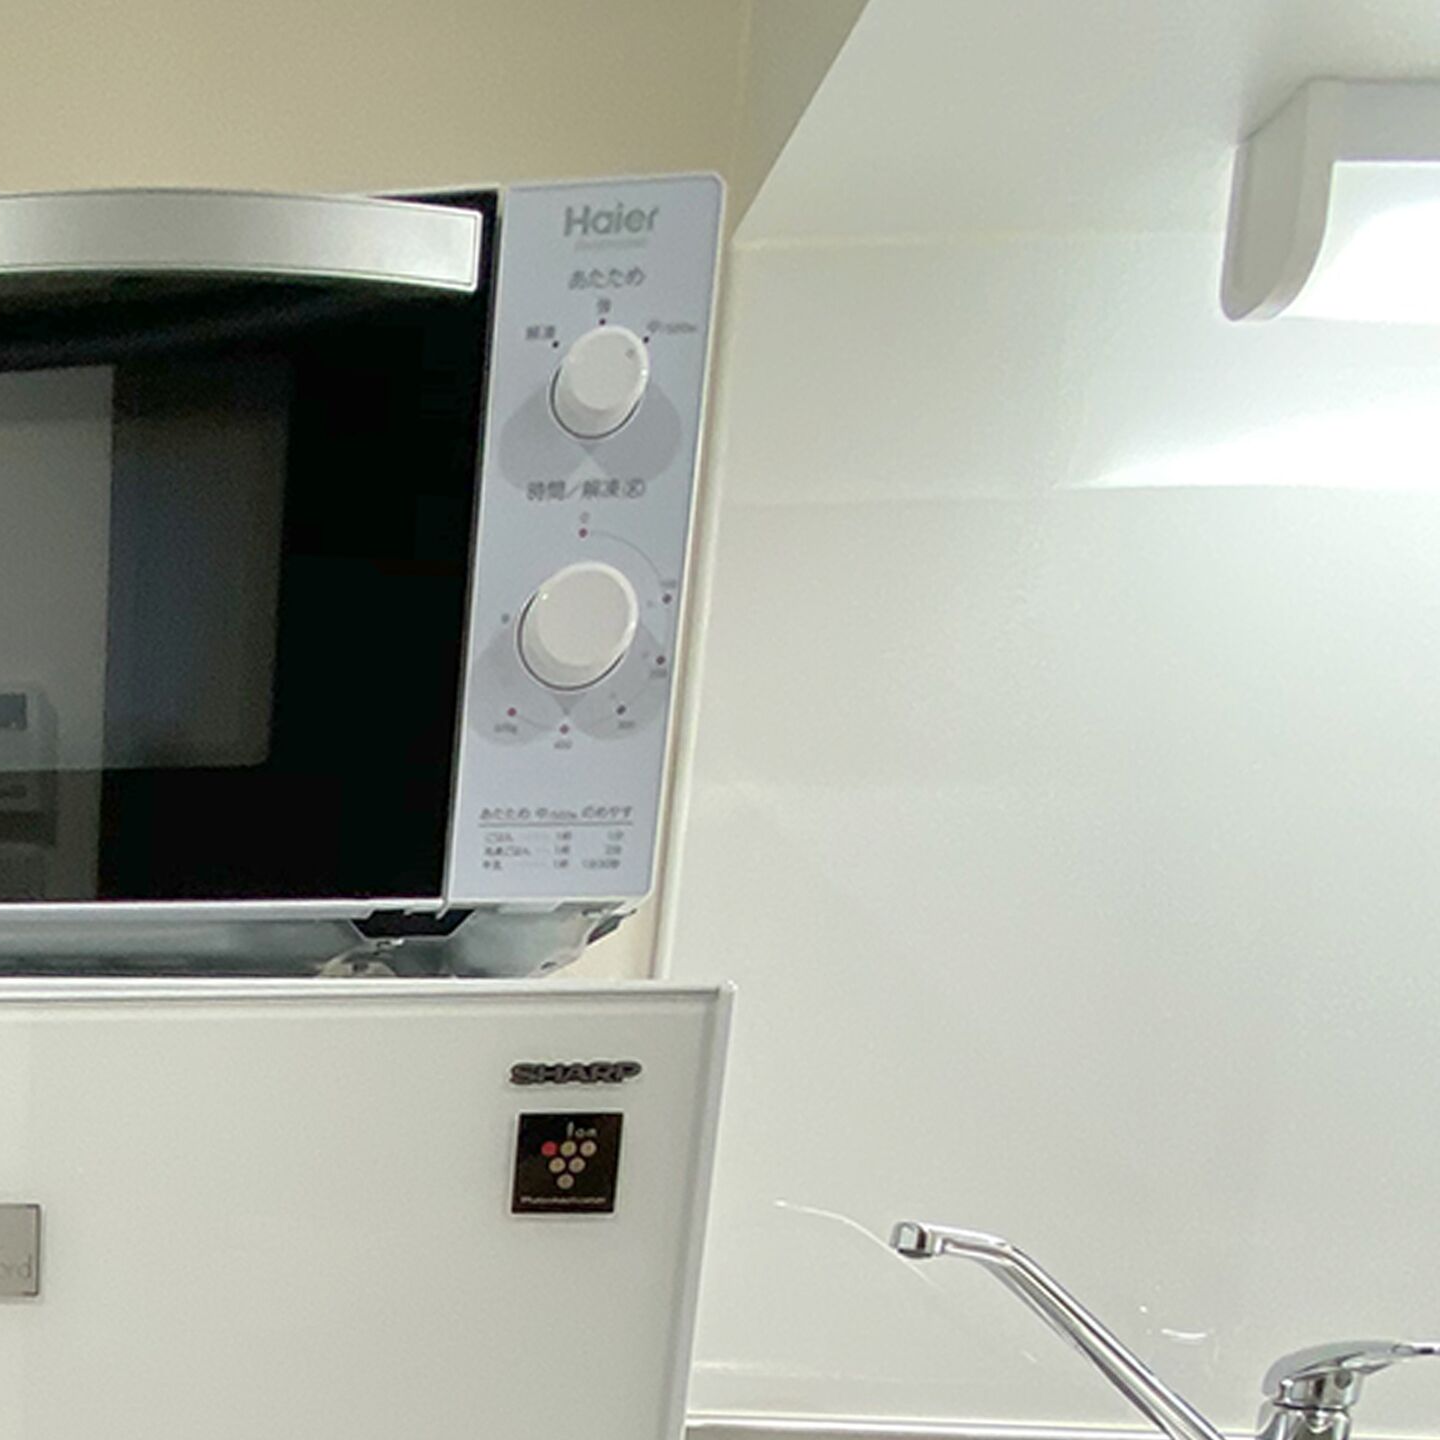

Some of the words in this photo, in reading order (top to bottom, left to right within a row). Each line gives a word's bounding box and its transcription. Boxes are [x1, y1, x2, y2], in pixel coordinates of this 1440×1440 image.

[563, 201, 659, 237] Haier
[568, 266, 646, 290] あたため
[510, 1061, 642, 1085] SHARP
